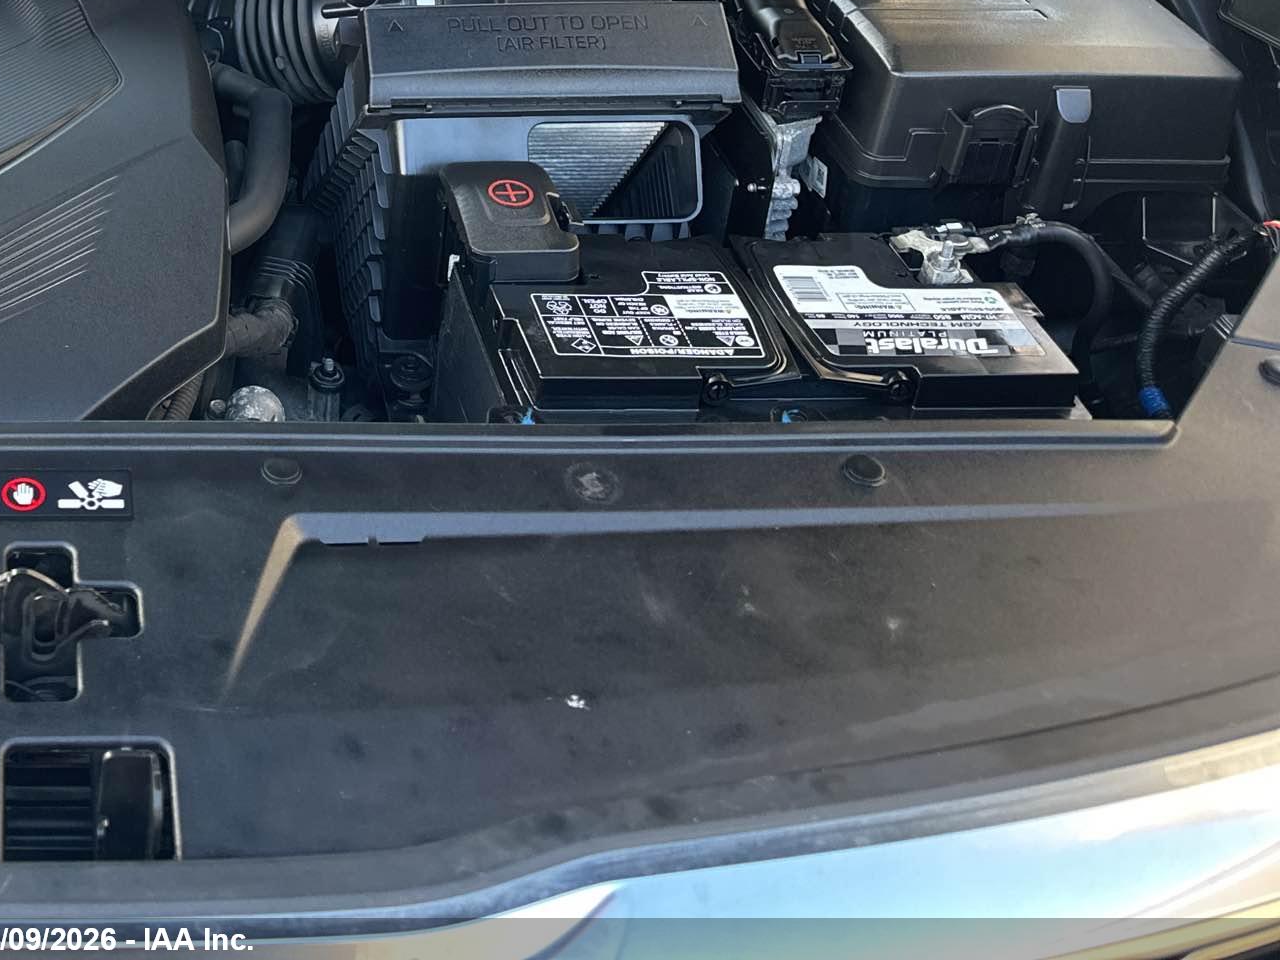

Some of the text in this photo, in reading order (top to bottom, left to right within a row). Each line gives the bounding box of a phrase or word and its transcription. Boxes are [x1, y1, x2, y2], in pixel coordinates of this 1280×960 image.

[447, 15, 649, 33] PULL OUT TO OPEN
[861, 330, 948, 338] PLATINUM
[864, 336, 999, 355] Duralast
